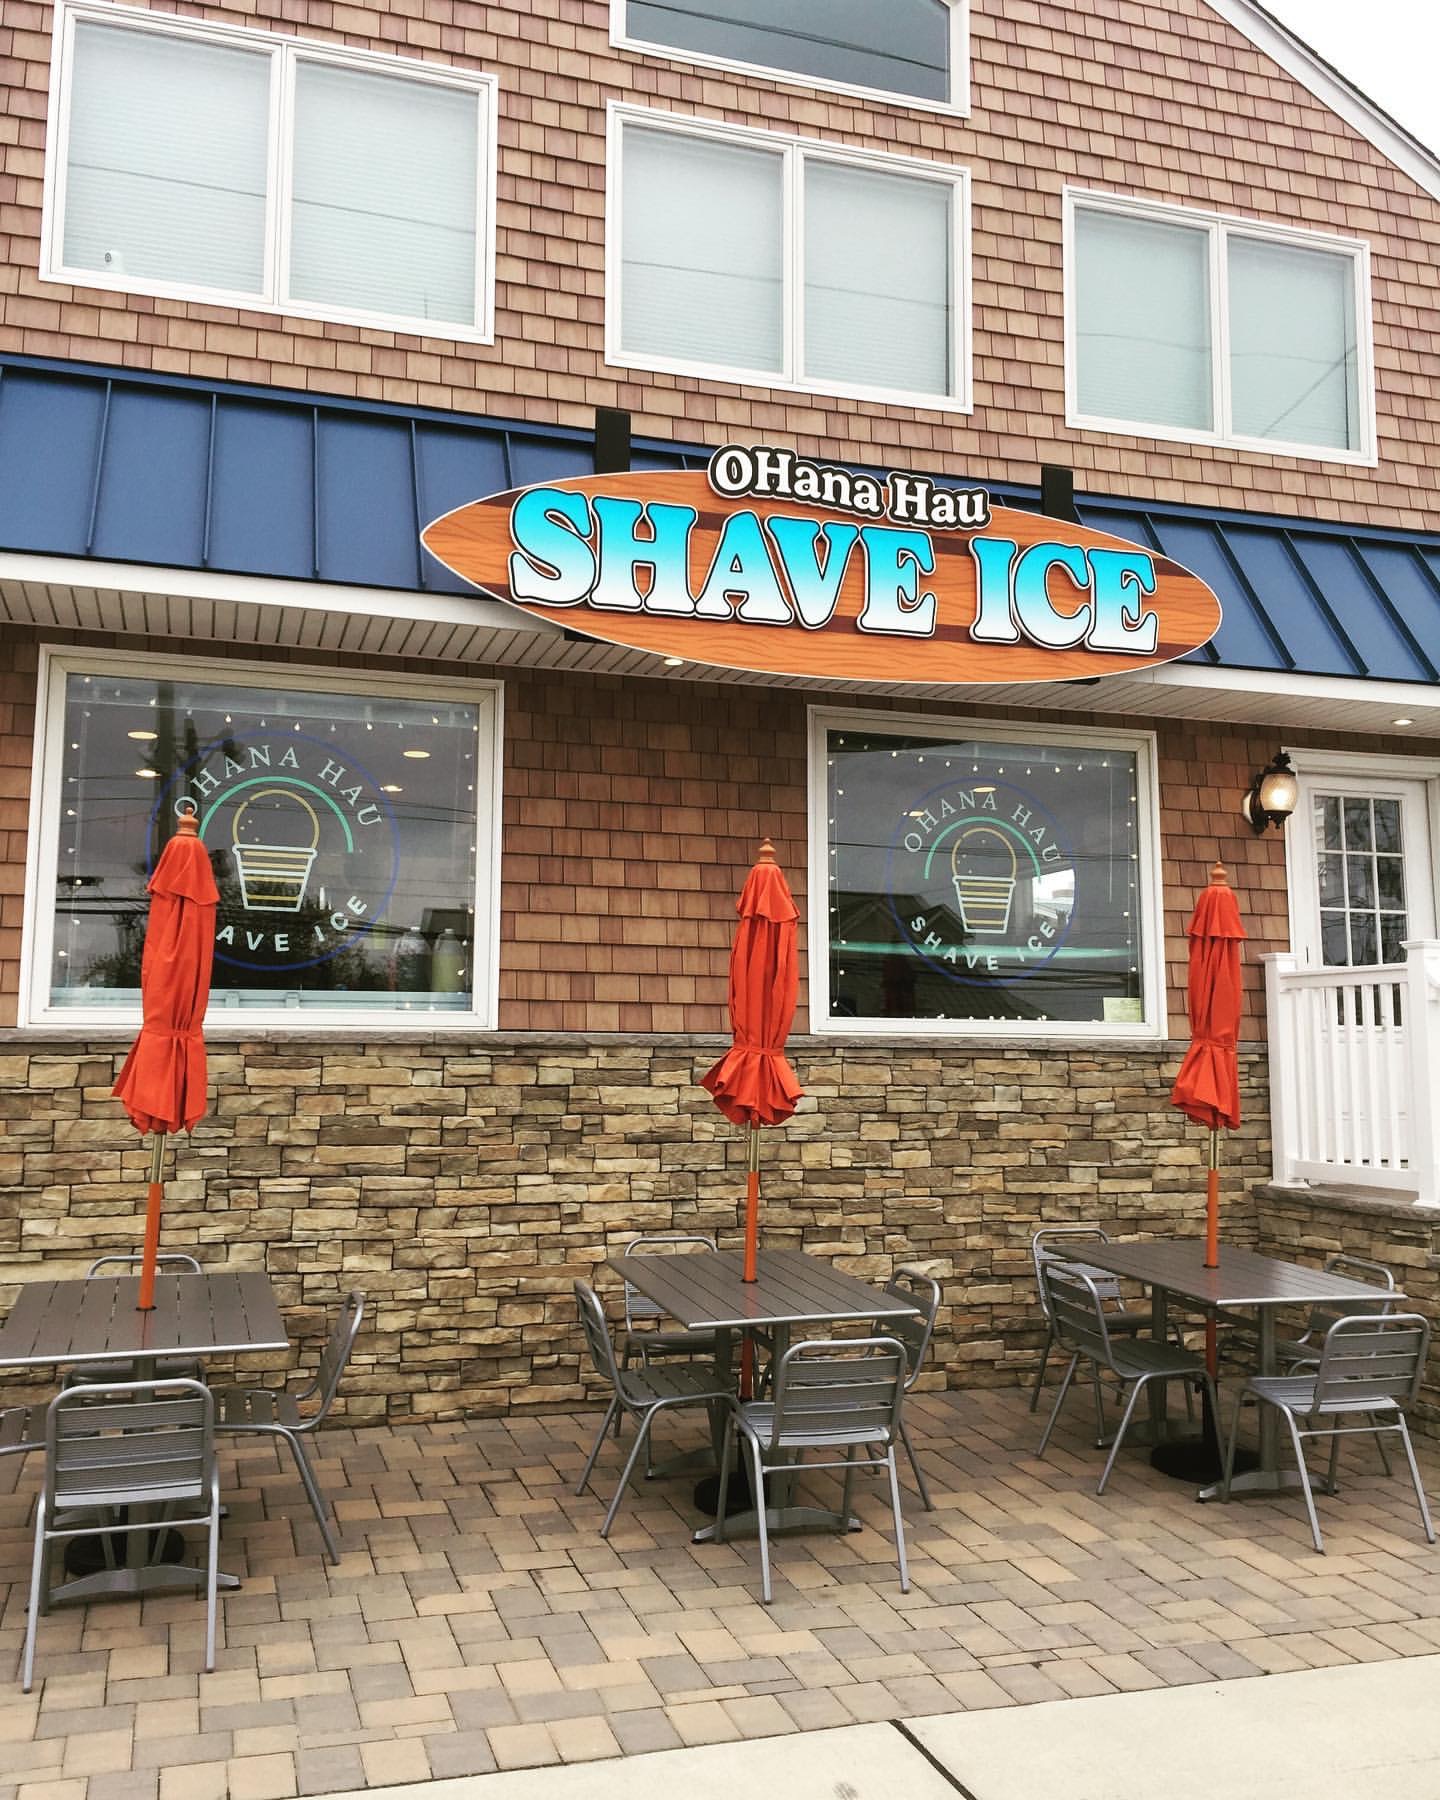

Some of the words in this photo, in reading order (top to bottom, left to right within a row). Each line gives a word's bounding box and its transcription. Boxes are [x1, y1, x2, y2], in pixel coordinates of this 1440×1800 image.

[713, 449, 880, 512] OHana
[889, 478, 989, 527] Hau
[509, 487, 939, 639] SHAVE
[971, 536, 1159, 654] ICE
[174, 744, 300, 820] OHANA
[318, 759, 383, 827] HAU
[903, 790, 998, 853] OHANA
[1010, 804, 1061, 863] HAU
[215, 924, 290, 953] AVE
[313, 894, 367, 942] ICE
[911, 916, 999, 971] SHAVE
[1016, 922, 1056, 962] ICE
